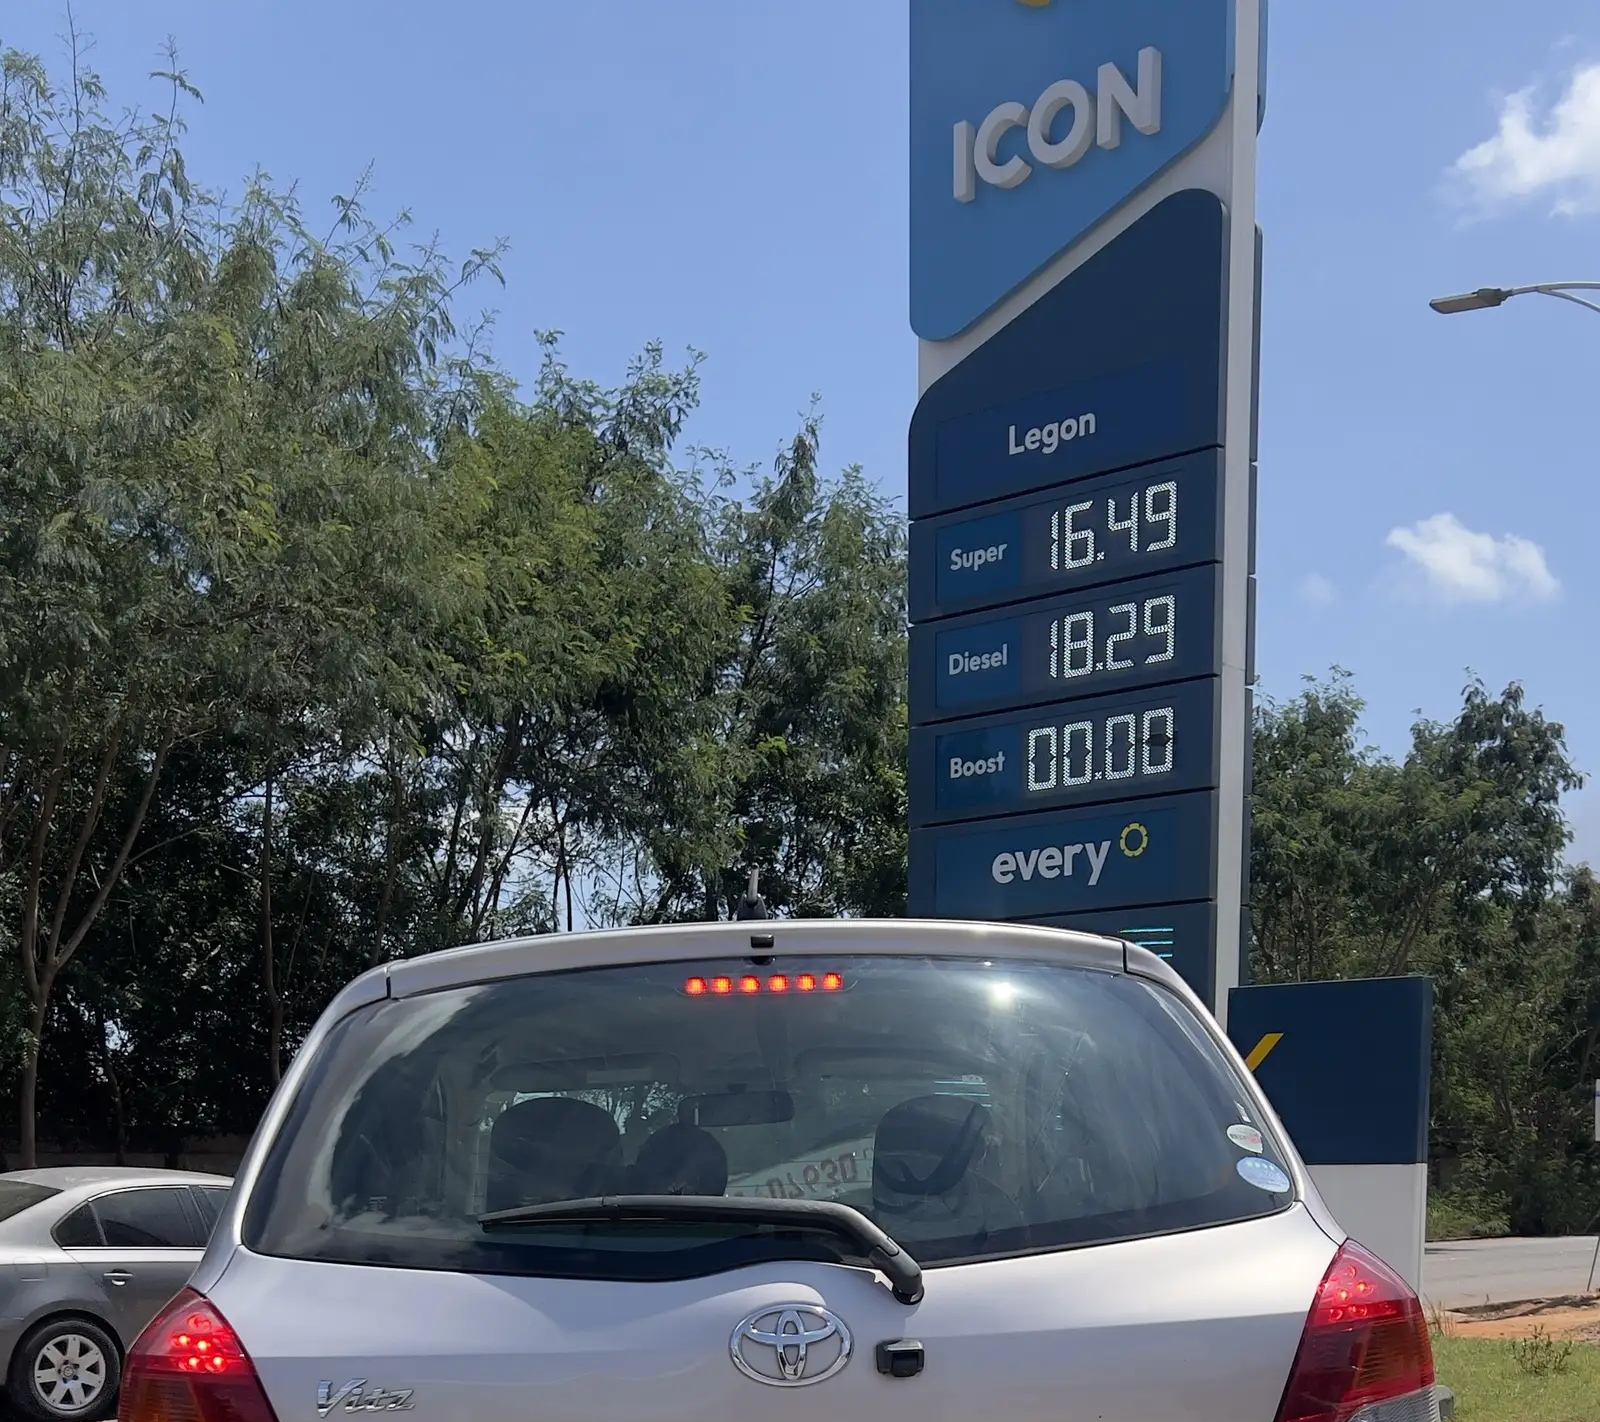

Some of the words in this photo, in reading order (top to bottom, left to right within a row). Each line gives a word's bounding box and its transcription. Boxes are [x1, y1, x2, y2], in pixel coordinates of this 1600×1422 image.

[953, 46, 1162, 203] ICON
[1008, 412, 1096, 456] Legon
[950, 543, 1008, 572] Super
[1050, 481, 1178, 571] 16.49
[948, 644, 1008, 676] Diesel
[1049, 594, 1176, 679] 18.29
[950, 751, 1006, 779] Boost
[1026, 706, 1174, 792] 00.00
[992, 839, 1112, 886] every
[317, 1378, 416, 1419] Vitz
